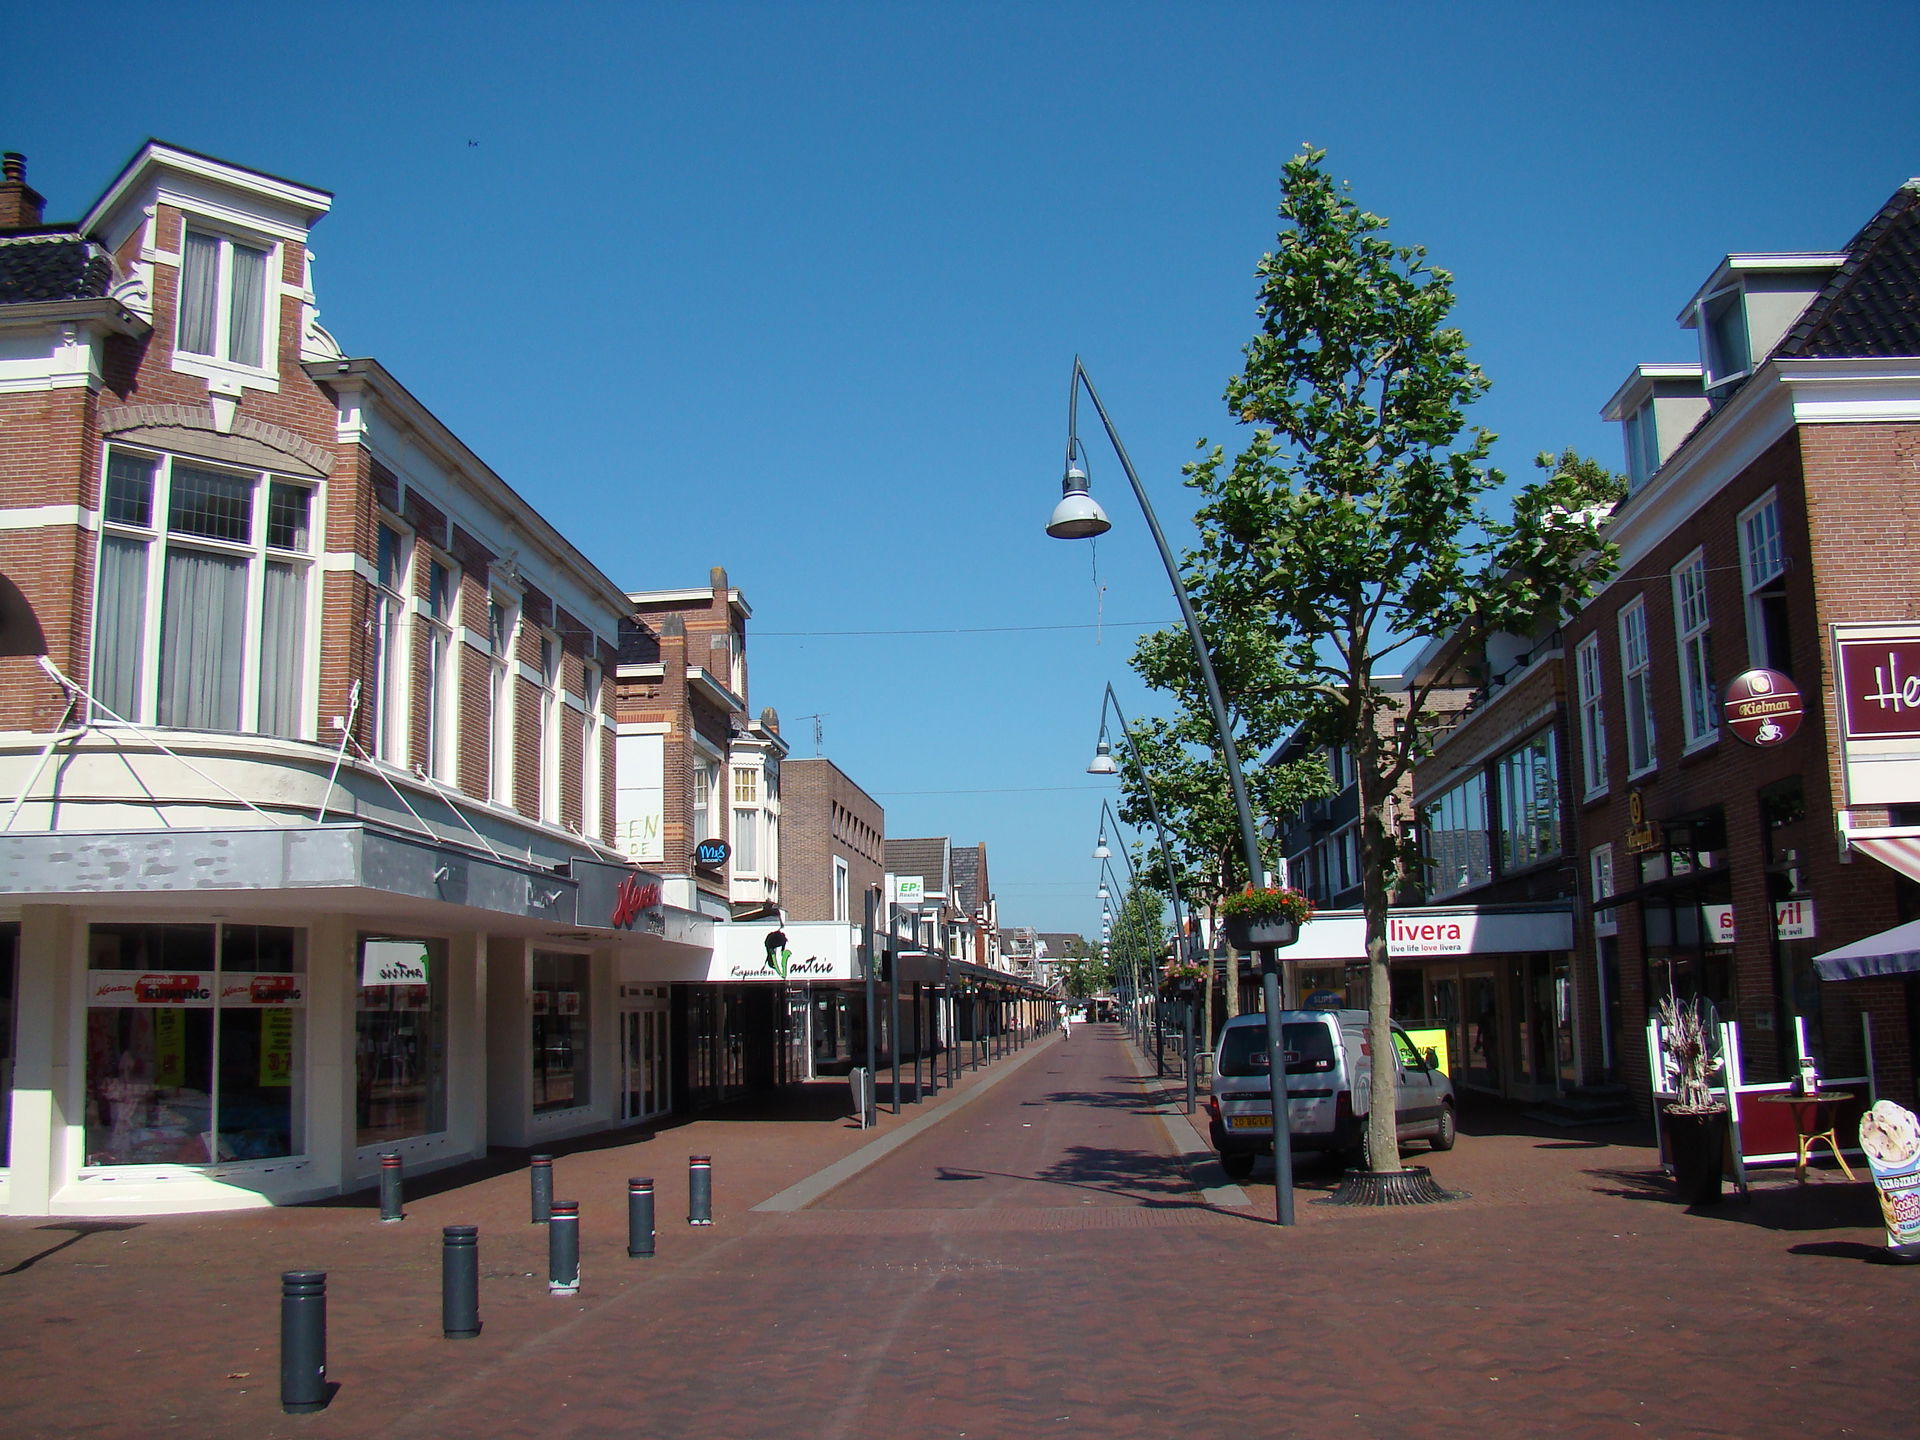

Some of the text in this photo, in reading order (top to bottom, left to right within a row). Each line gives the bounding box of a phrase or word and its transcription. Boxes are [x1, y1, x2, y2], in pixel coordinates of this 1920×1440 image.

[1863, 651, 1920, 713] He
[1738, 701, 1791, 716] Kielman
[900, 883, 921, 892] EP:
[1390, 919, 1461, 941] livera
[1390, 945, 1405, 953] live
[1892, 1194, 1919, 1211] Cookie
